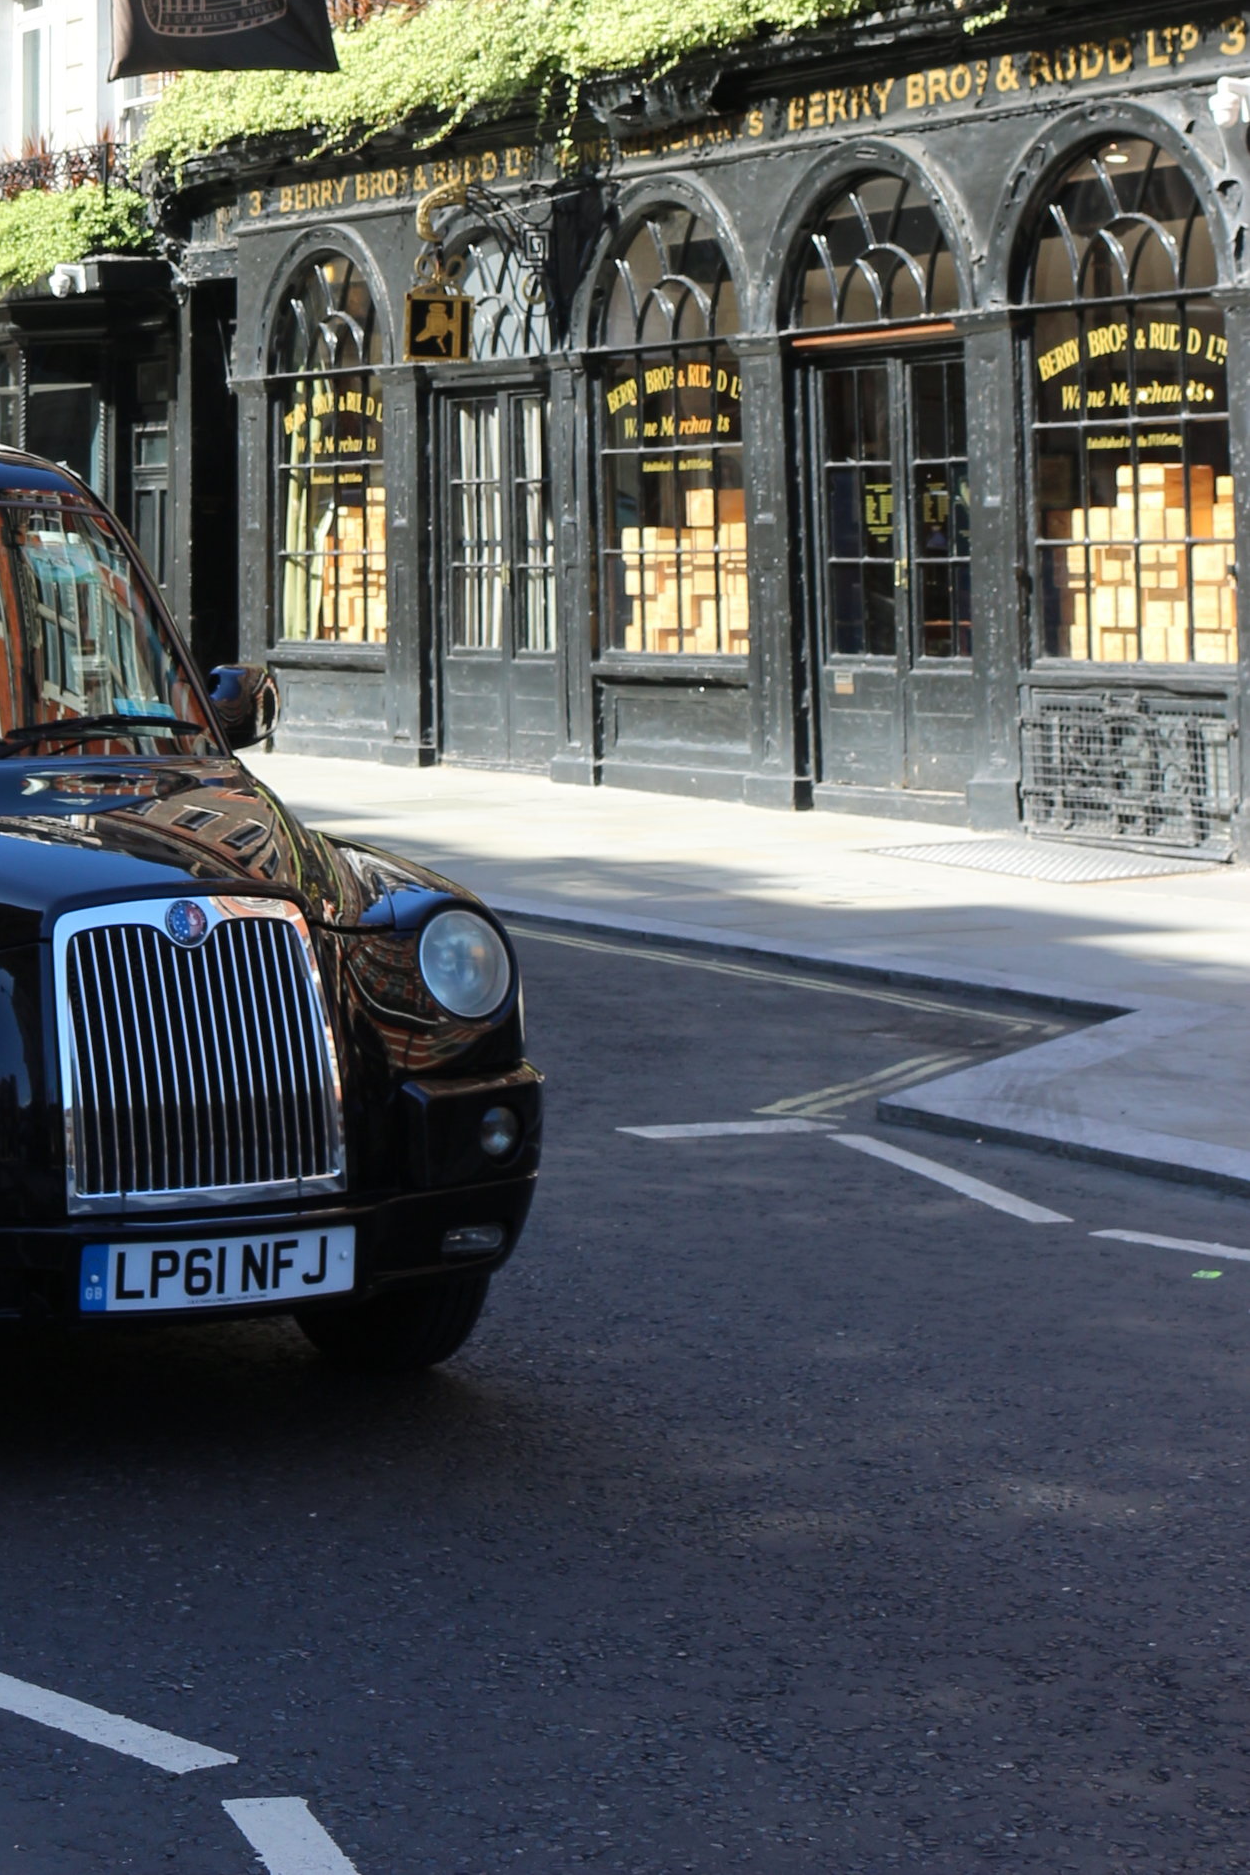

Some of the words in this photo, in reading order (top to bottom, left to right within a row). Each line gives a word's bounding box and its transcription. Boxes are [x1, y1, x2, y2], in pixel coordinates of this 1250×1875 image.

[249, 191, 262, 217] 3
[279, 176, 350, 213] BERRY
[412, 164, 429, 191] &
[432, 150, 497, 186] RUDD
[788, 78, 896, 132] BERRY
[995, 54, 1020, 93] &
[1029, 36, 1134, 88] RUDD
[1219, 15, 1247, 56] 3
[1037, 337, 1081, 383] BERRY
[1133, 327, 1146, 351] &
[1149, 321, 1202, 356] RUDD
[337, 395, 346, 412] &
[606, 377, 638, 415] BERRY
[676, 369, 686, 388] &
[1061, 384, 1106, 412] Wine
[1108, 378, 1207, 408] Merchants
[241, 1235, 329, 1293] NFJ
[84, 1286, 104, 1301] GB
